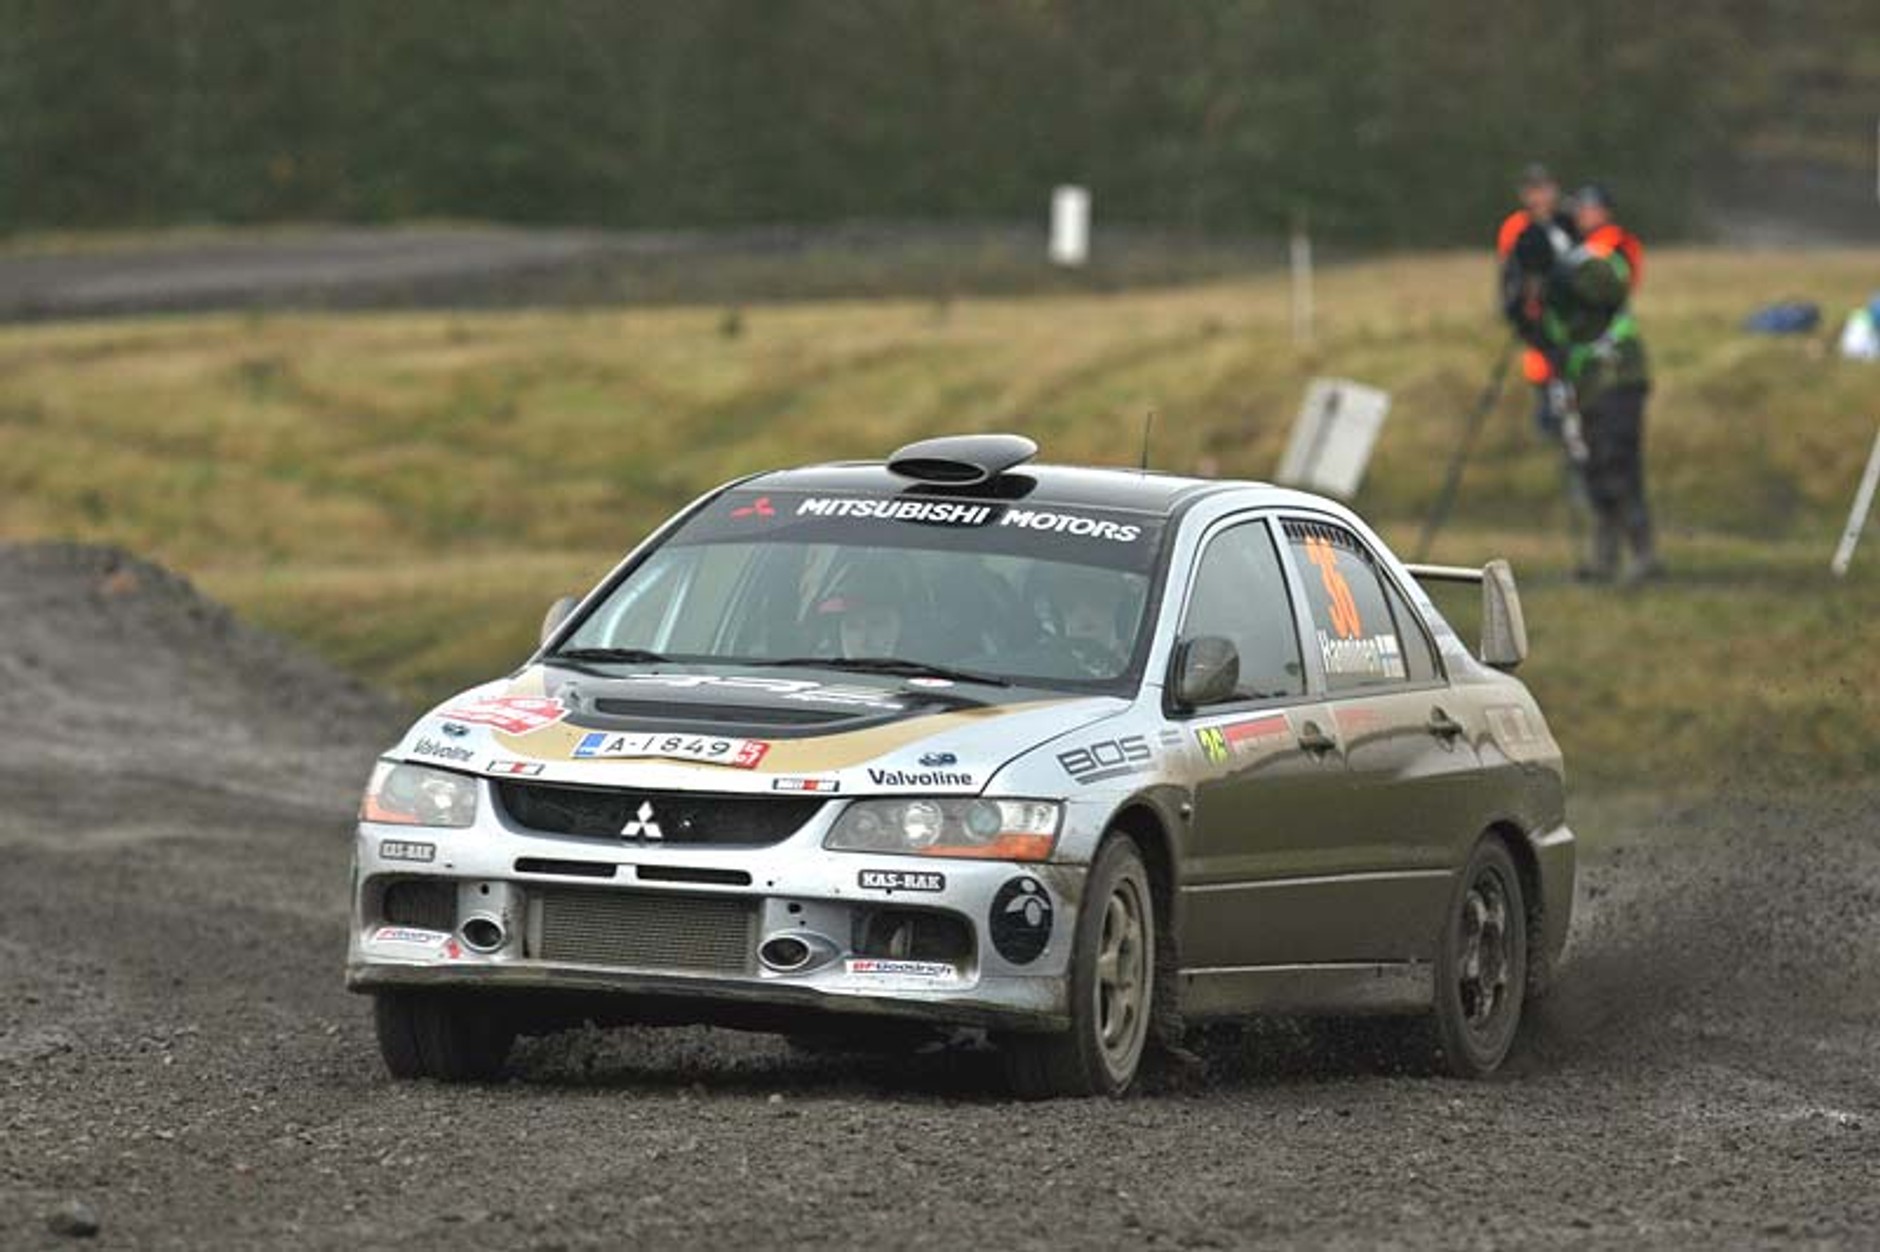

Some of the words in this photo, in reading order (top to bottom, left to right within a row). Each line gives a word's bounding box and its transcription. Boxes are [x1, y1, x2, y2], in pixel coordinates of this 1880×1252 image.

[796, 498, 990, 524] MITSUBISHI
[1001, 509, 1141, 542] MOTORS
[867, 767, 972, 786] Valvoline
